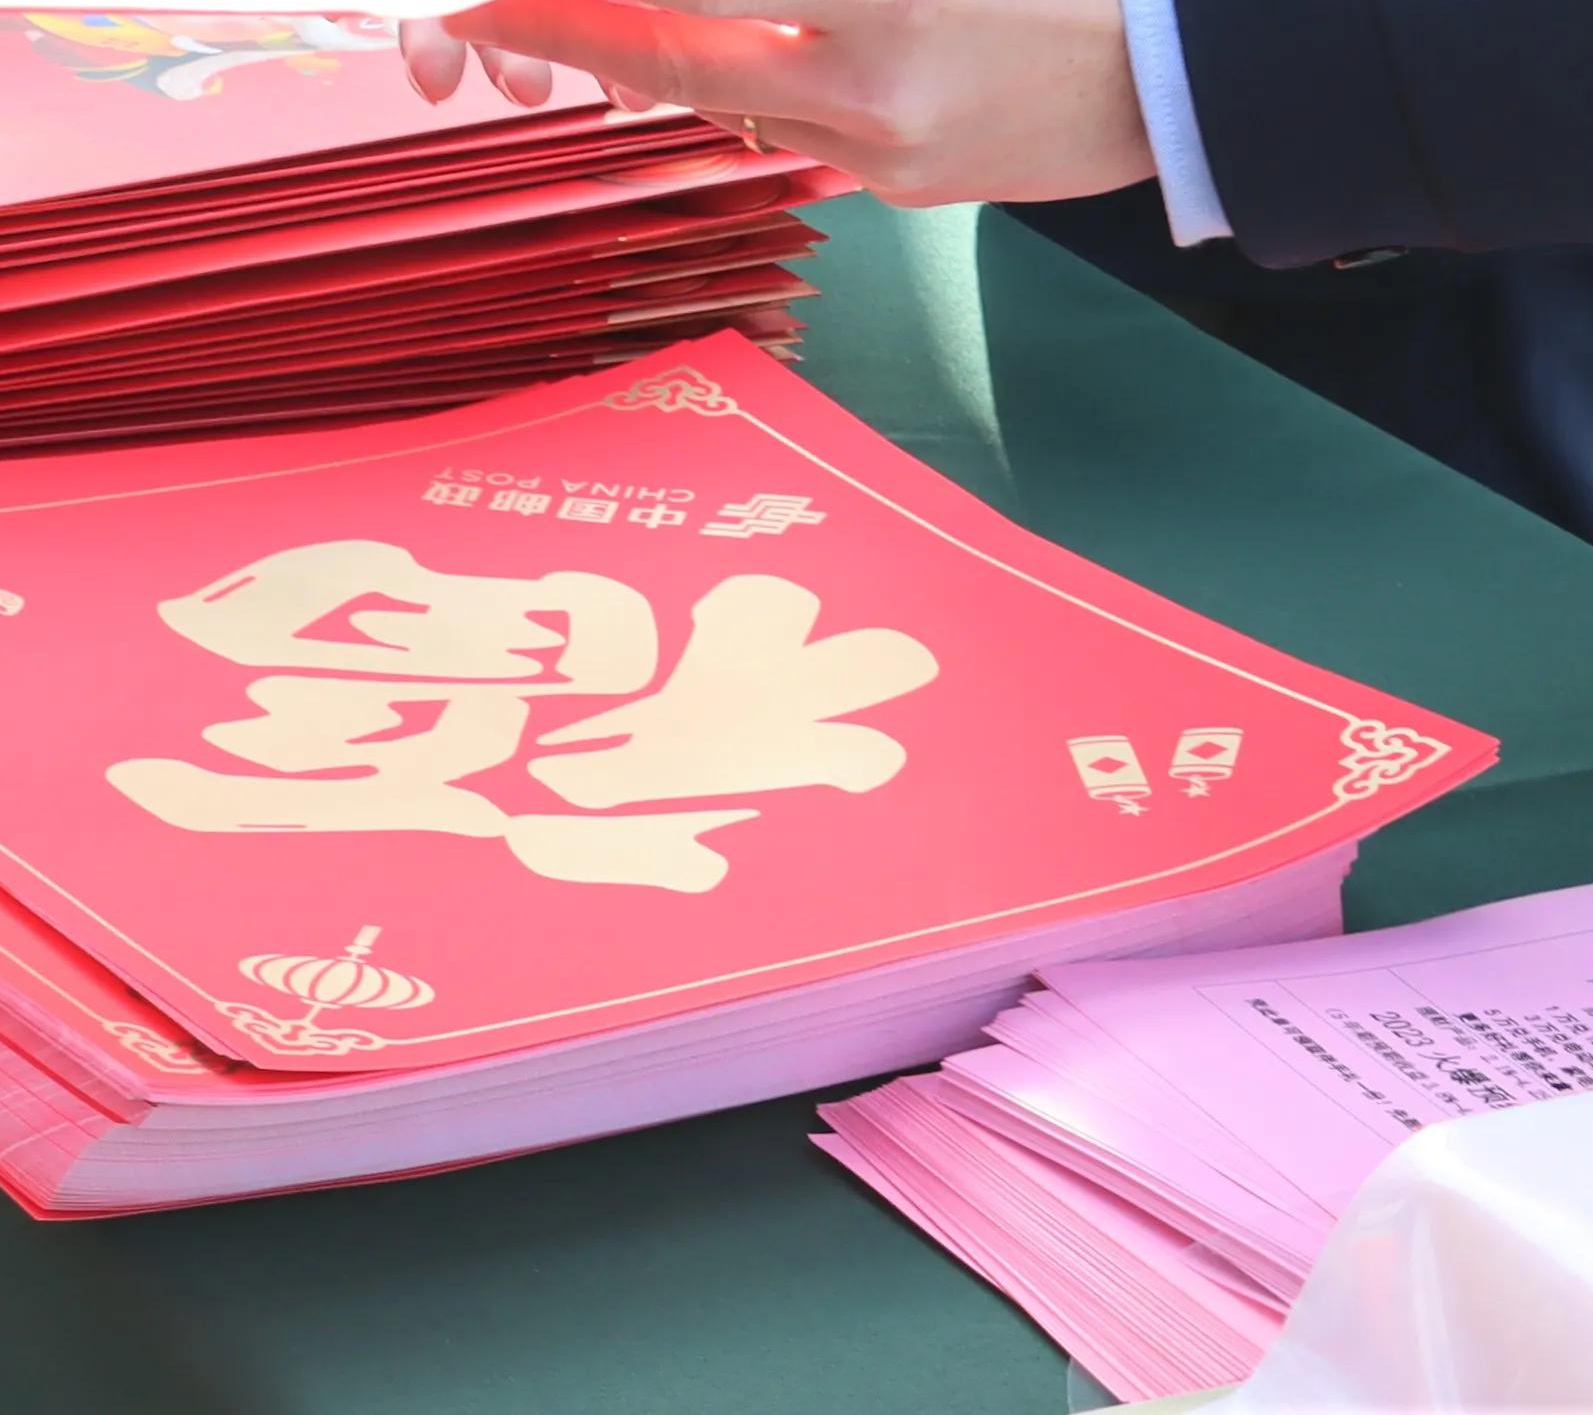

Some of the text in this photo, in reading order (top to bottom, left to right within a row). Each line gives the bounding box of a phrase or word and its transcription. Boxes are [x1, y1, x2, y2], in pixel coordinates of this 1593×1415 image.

[421, 480, 688, 530] 中国邮政
[434, 466, 697, 504] CHINA POST
